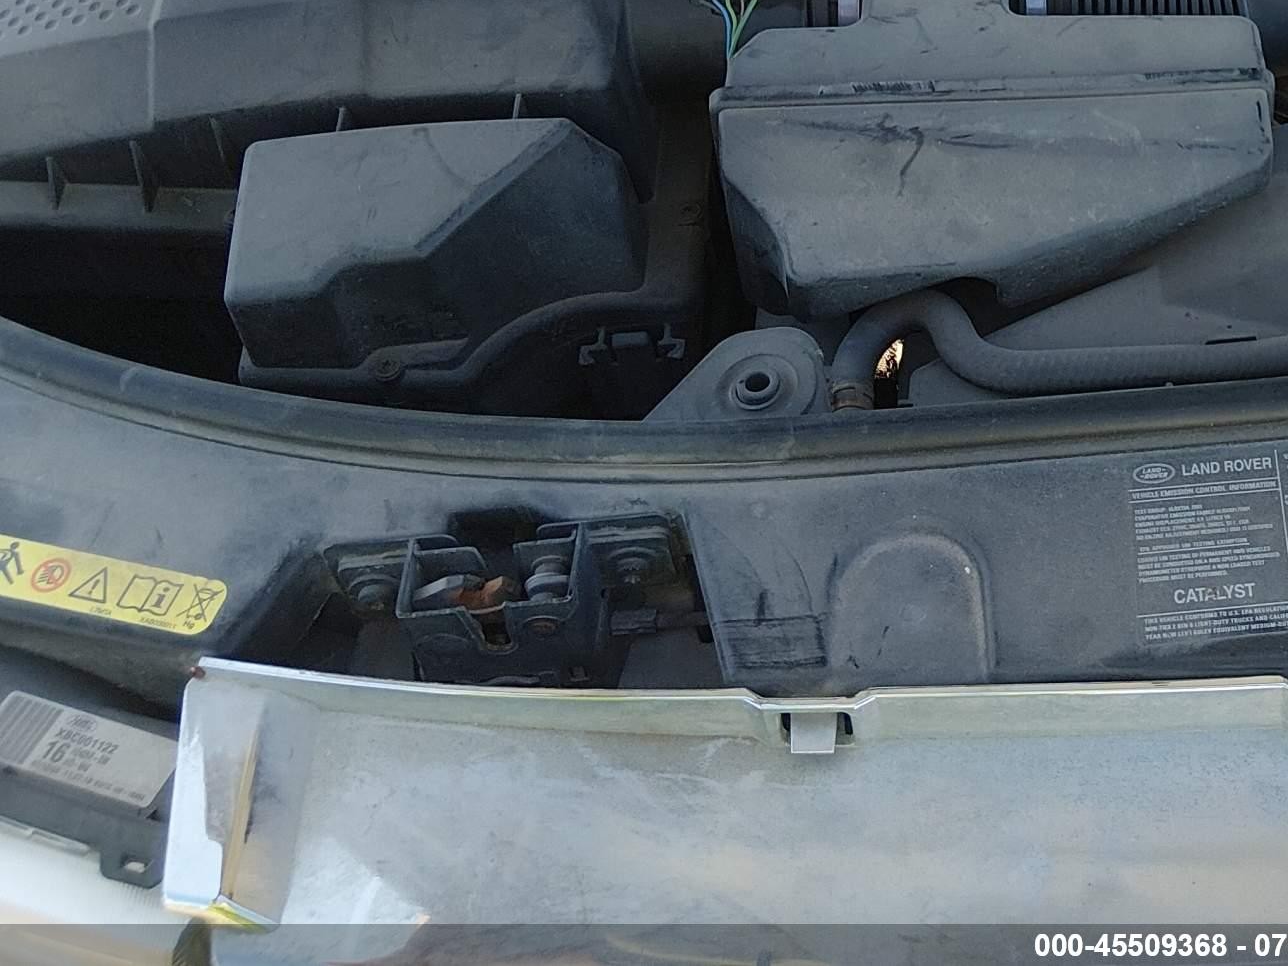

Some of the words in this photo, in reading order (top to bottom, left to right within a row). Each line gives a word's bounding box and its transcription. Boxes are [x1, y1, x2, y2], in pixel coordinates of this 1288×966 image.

[1182, 461, 1220, 476] LAND
[1224, 457, 1272, 472] ROVER
[1144, 472, 1169, 480] ROVER
[1132, 491, 1159, 499] VEHICLE
[1160, 489, 1194, 497] EMISSION
[1195, 486, 1226, 494] CONTROL
[1229, 481, 1277, 490] INFORMATION
[1174, 582, 1255, 604] CATALYST
[183, 620, 195, 629] Hg
[43, 739, 71, 763] 16
